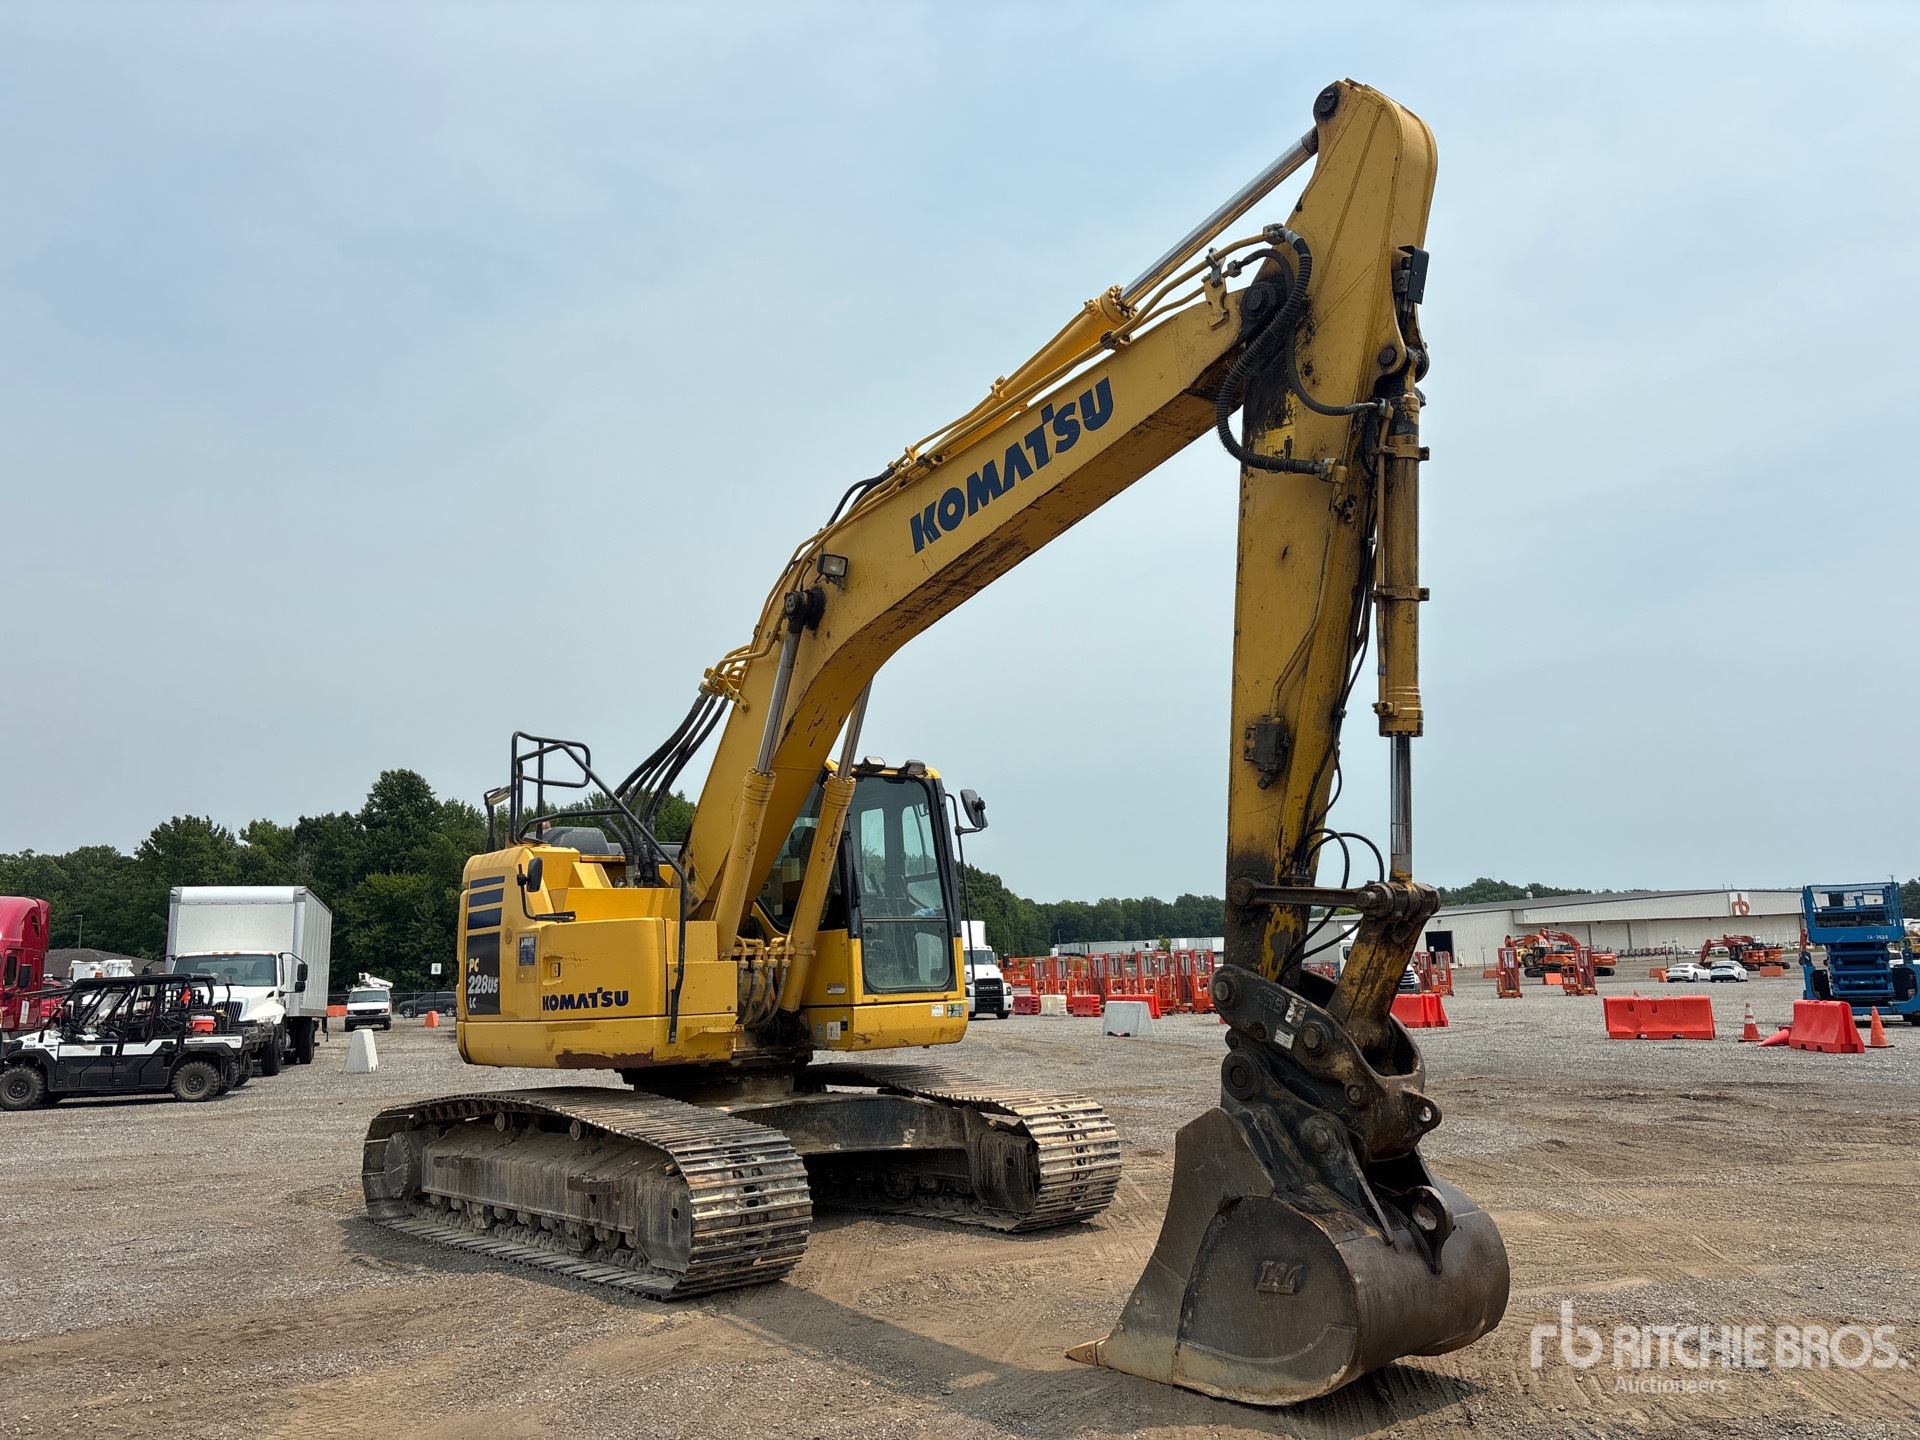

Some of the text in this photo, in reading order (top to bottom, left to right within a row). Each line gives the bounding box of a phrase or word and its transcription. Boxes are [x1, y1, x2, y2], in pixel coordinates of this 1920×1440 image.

[910, 376, 1113, 554] KOMATSU
[1731, 892, 1750, 916] rb
[469, 958, 479, 972] PC
[468, 975, 498, 994] 228US
[469, 997, 476, 1008] LC
[542, 987, 628, 1011] KOMATSU
